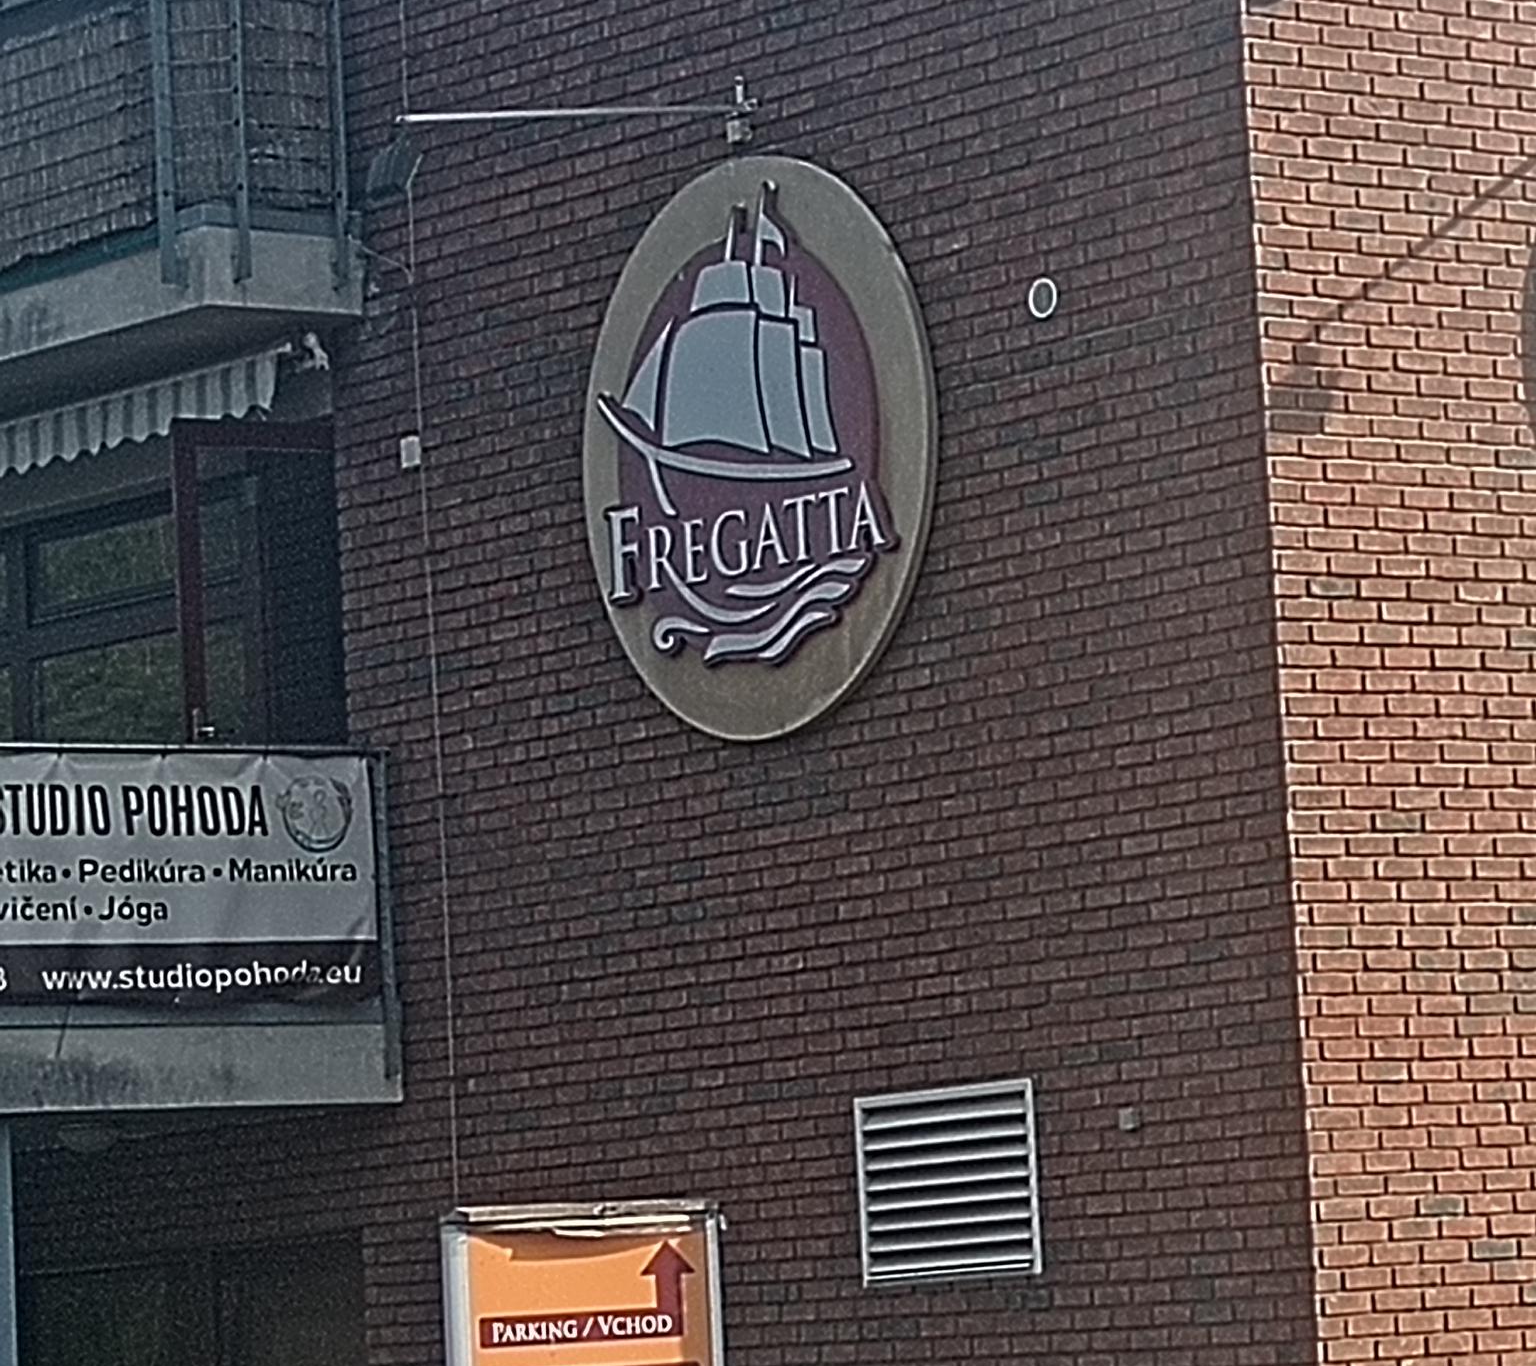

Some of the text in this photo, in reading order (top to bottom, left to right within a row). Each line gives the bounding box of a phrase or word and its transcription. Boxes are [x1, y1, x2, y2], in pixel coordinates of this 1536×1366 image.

[605, 480, 886, 601] FREGATTA
[0, 783, 269, 837] TUDIO POHODA
[0, 857, 358, 884] tika Pedikúra Manikúra
[98, 895, 169, 927] Jóga
[42, 959, 362, 993] www.studiopohoda.eu
